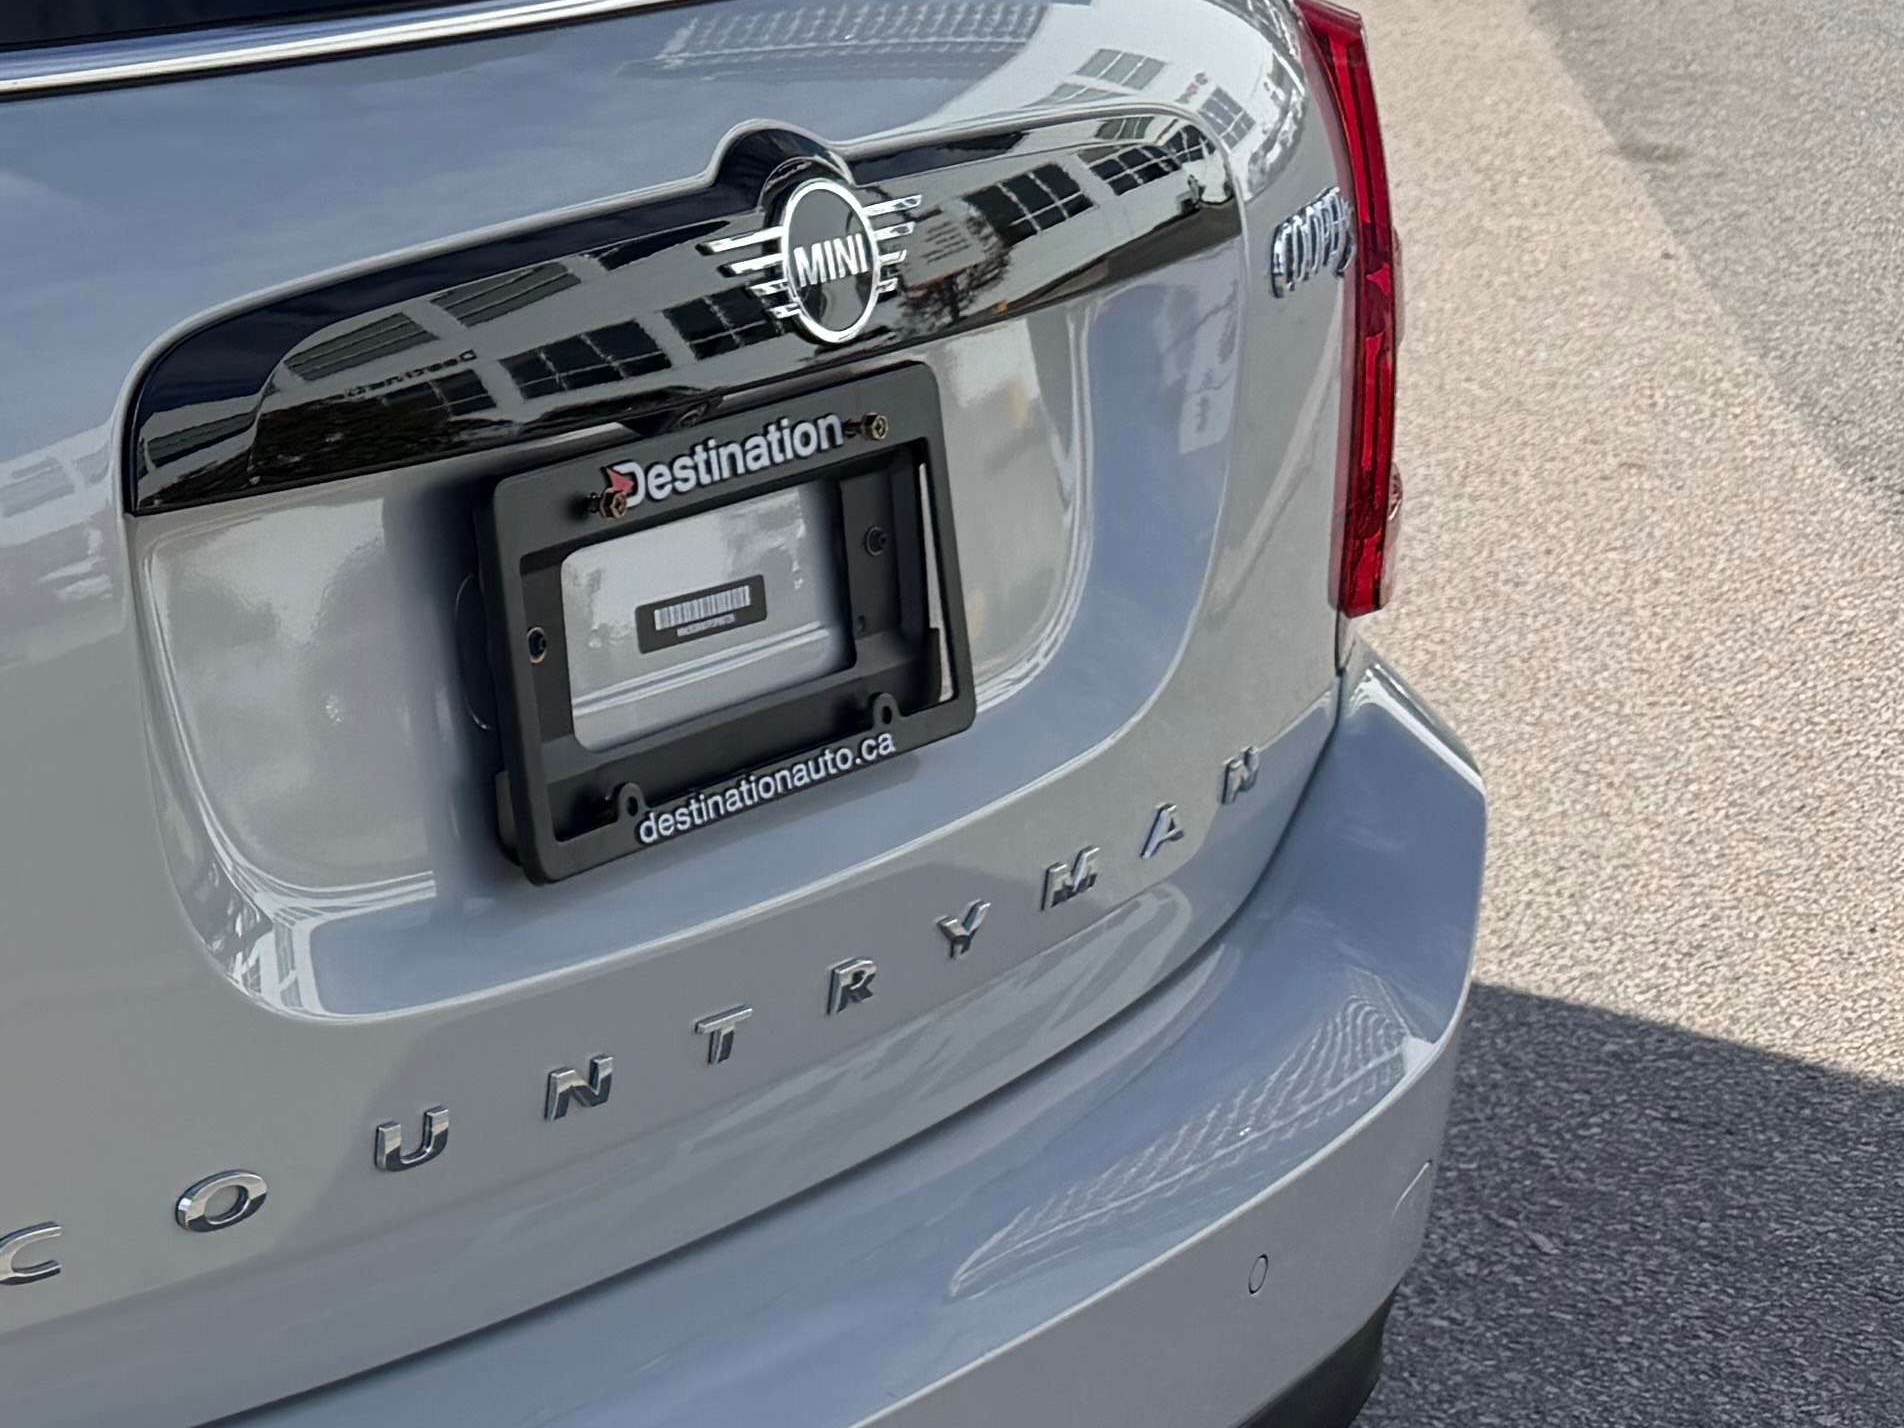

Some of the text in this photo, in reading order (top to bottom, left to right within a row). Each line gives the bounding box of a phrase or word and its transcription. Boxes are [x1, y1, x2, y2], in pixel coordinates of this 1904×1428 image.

[793, 233, 867, 288] MINI
[607, 413, 844, 509] Destination
[639, 732, 896, 844] destinationauto.ca
